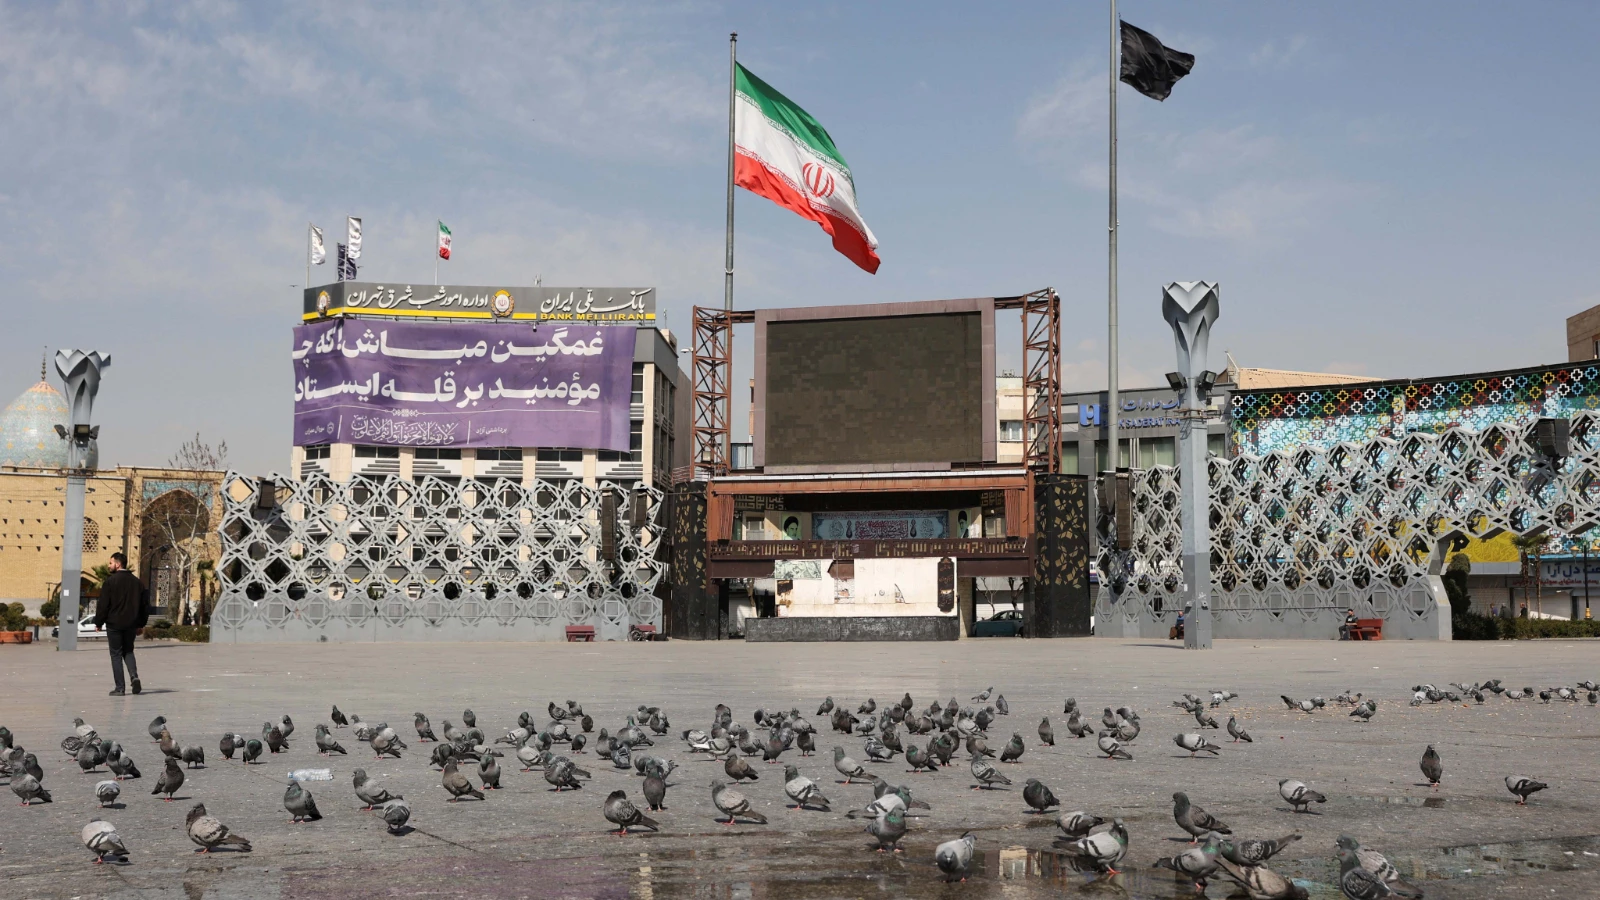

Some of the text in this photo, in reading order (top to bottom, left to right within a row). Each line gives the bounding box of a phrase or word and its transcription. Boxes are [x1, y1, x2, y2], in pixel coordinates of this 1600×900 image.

[347, 285, 488, 309] اداره امور شعب شرق تهران
[540, 292, 574, 313] ایران
[591, 288, 651, 313] بانک
[491, 327, 604, 363] غمگین
[381, 371, 457, 403] قله
[456, 382, 484, 408] بر
[488, 372, 601, 406] مؤمنید
[475, 426, 508, 435] برداشتی آزاد
[1126, 416, 1164, 429] SADERAT
[1166, 416, 1181, 427] IRA
[1547, 562, 1561, 578] آرا
[1563, 565, 1581, 578] دل
